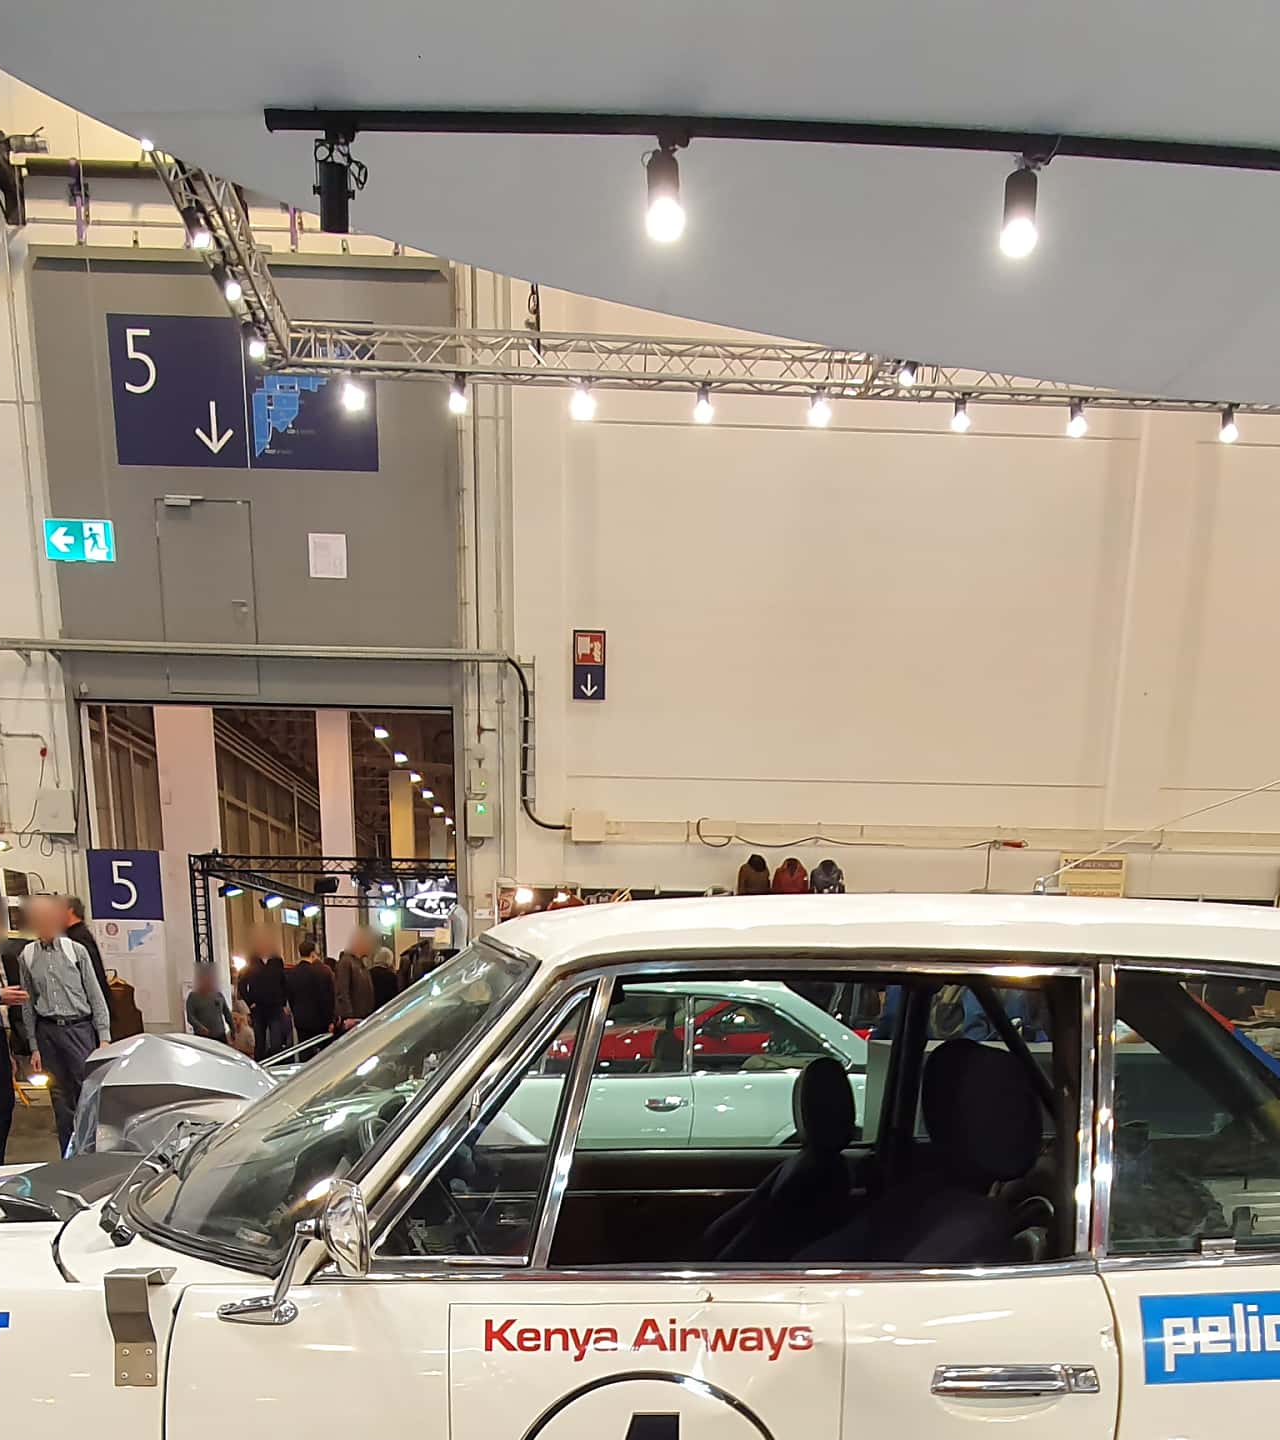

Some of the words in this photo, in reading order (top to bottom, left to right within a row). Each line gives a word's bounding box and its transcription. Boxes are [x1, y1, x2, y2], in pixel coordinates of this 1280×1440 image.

[124, 328, 157, 394] 5
[111, 860, 138, 910] 5
[483, 1318, 618, 1362] Kenya
[632, 1318, 814, 1362] Airways
